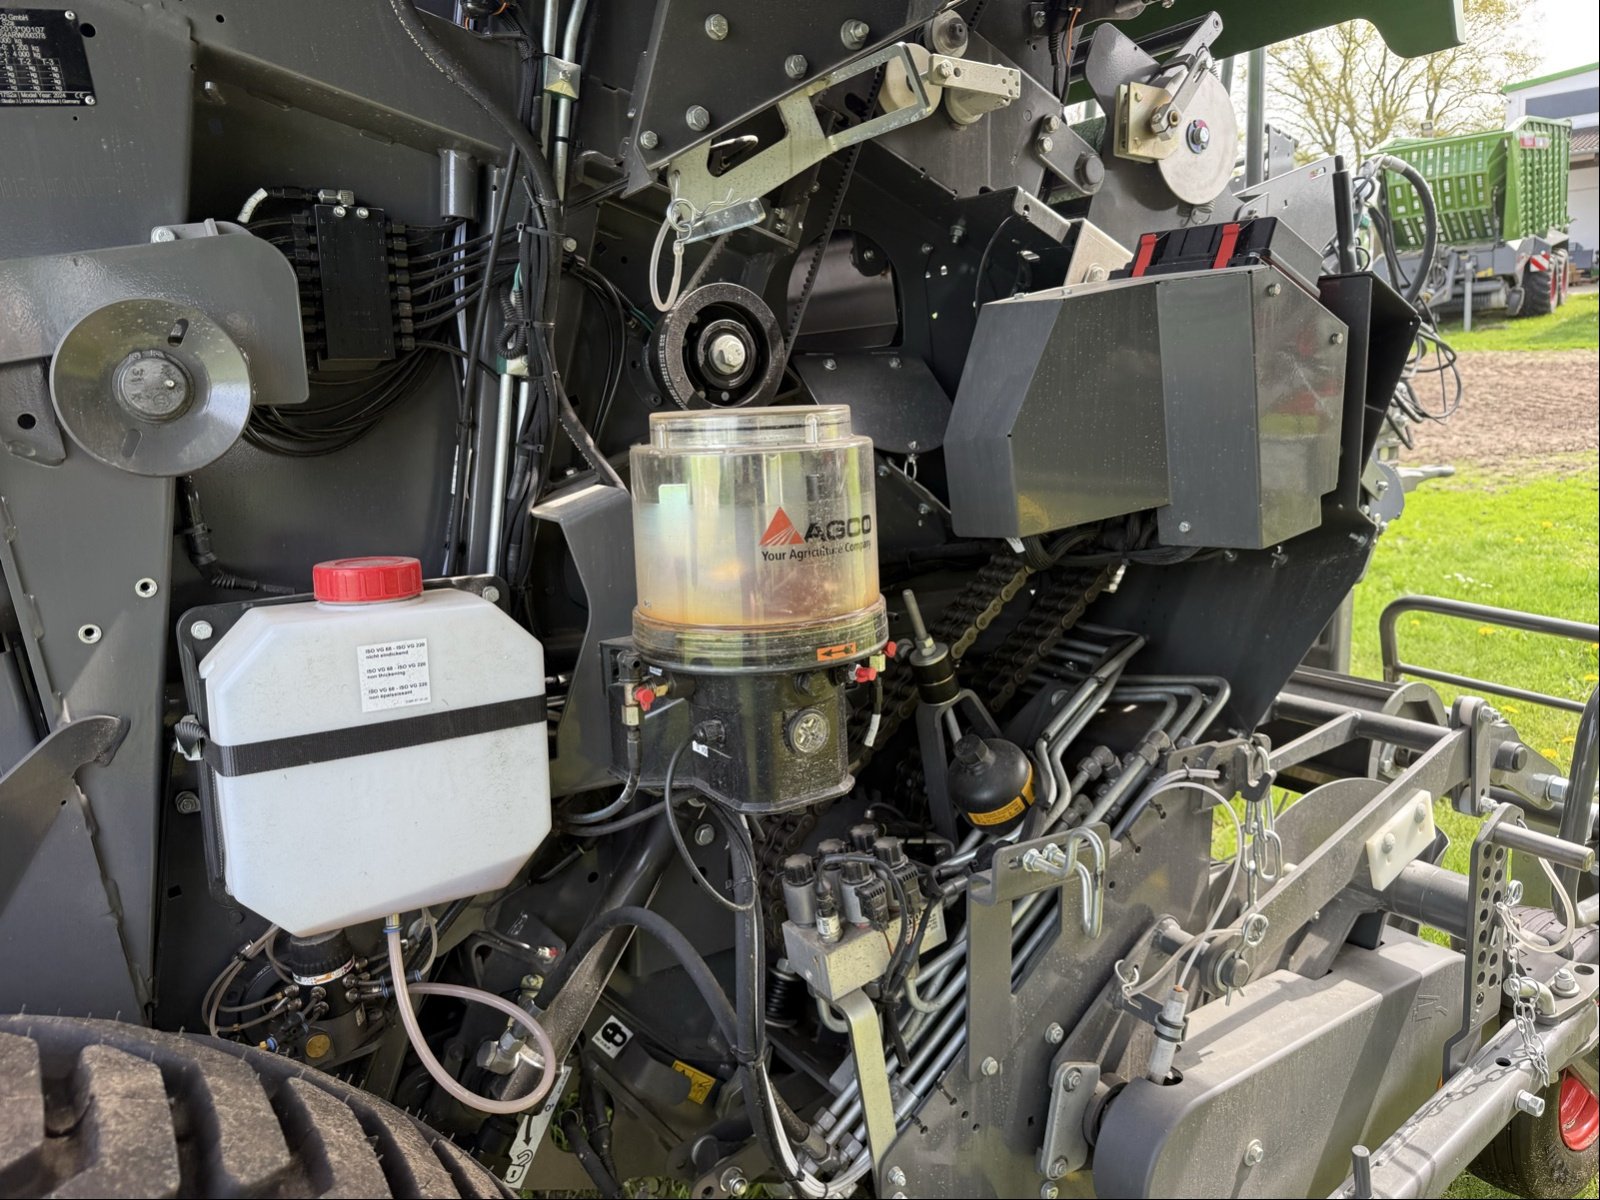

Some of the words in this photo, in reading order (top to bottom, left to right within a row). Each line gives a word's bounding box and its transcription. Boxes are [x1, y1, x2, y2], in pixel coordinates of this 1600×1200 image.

[804, 514, 871, 542] AGCO
[762, 550, 786, 561] Your
[789, 544, 844, 561] Agriculture
[845, 540, 871, 552] Company
